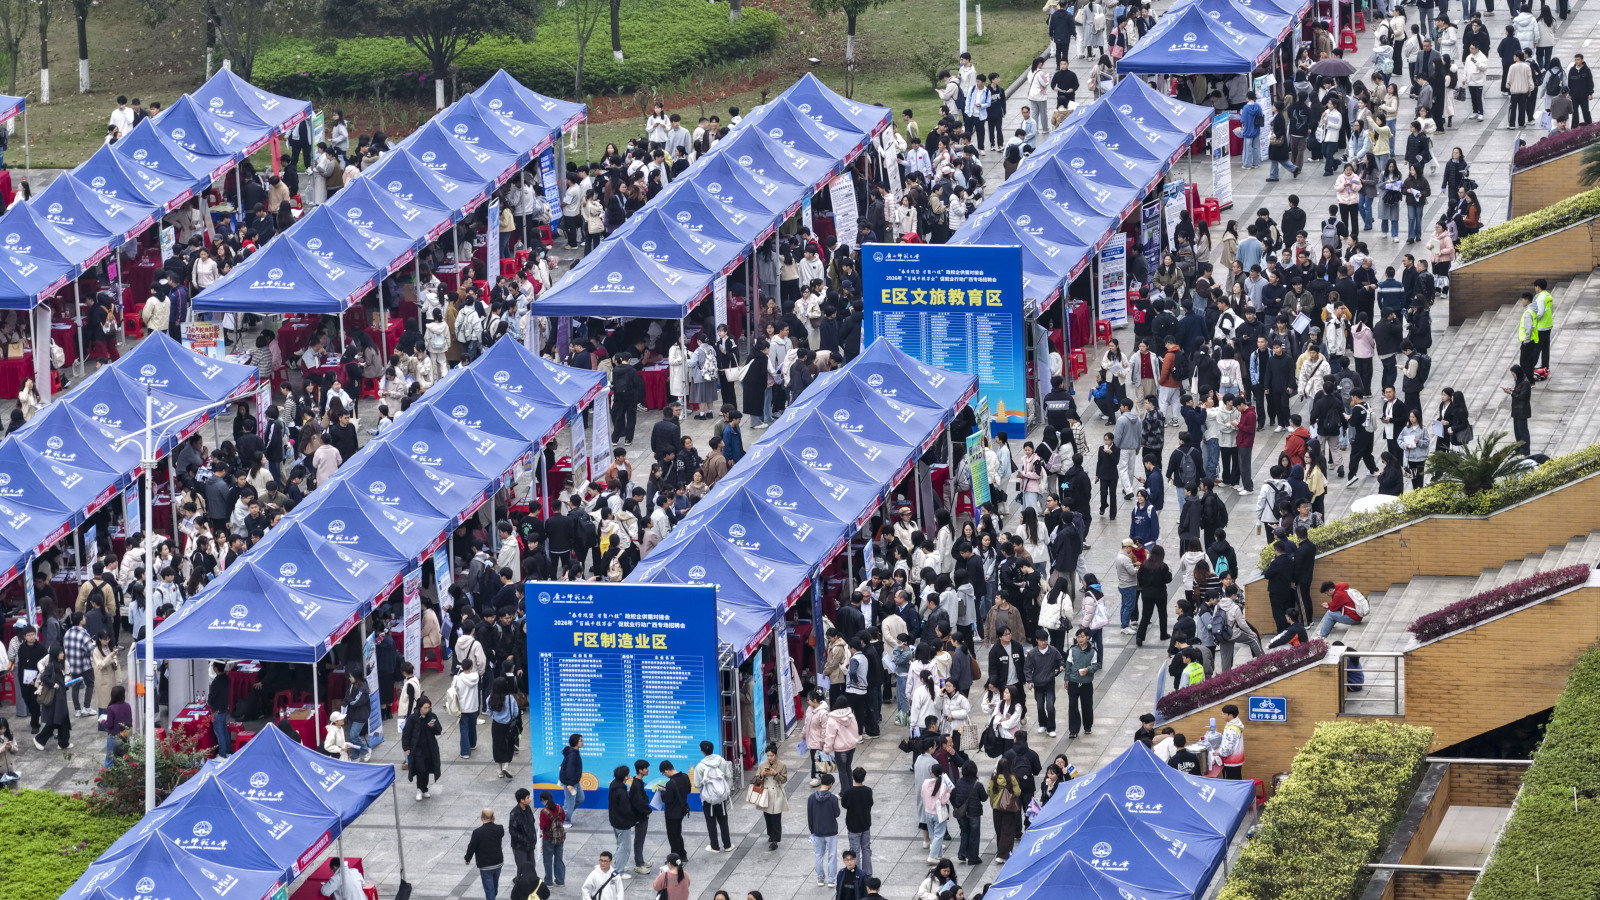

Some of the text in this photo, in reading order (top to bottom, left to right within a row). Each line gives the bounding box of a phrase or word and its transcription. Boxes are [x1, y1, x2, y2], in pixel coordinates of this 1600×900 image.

[882, 288, 1002, 306] E区文旅教育区
[574, 632, 667, 649] F区制造业区
